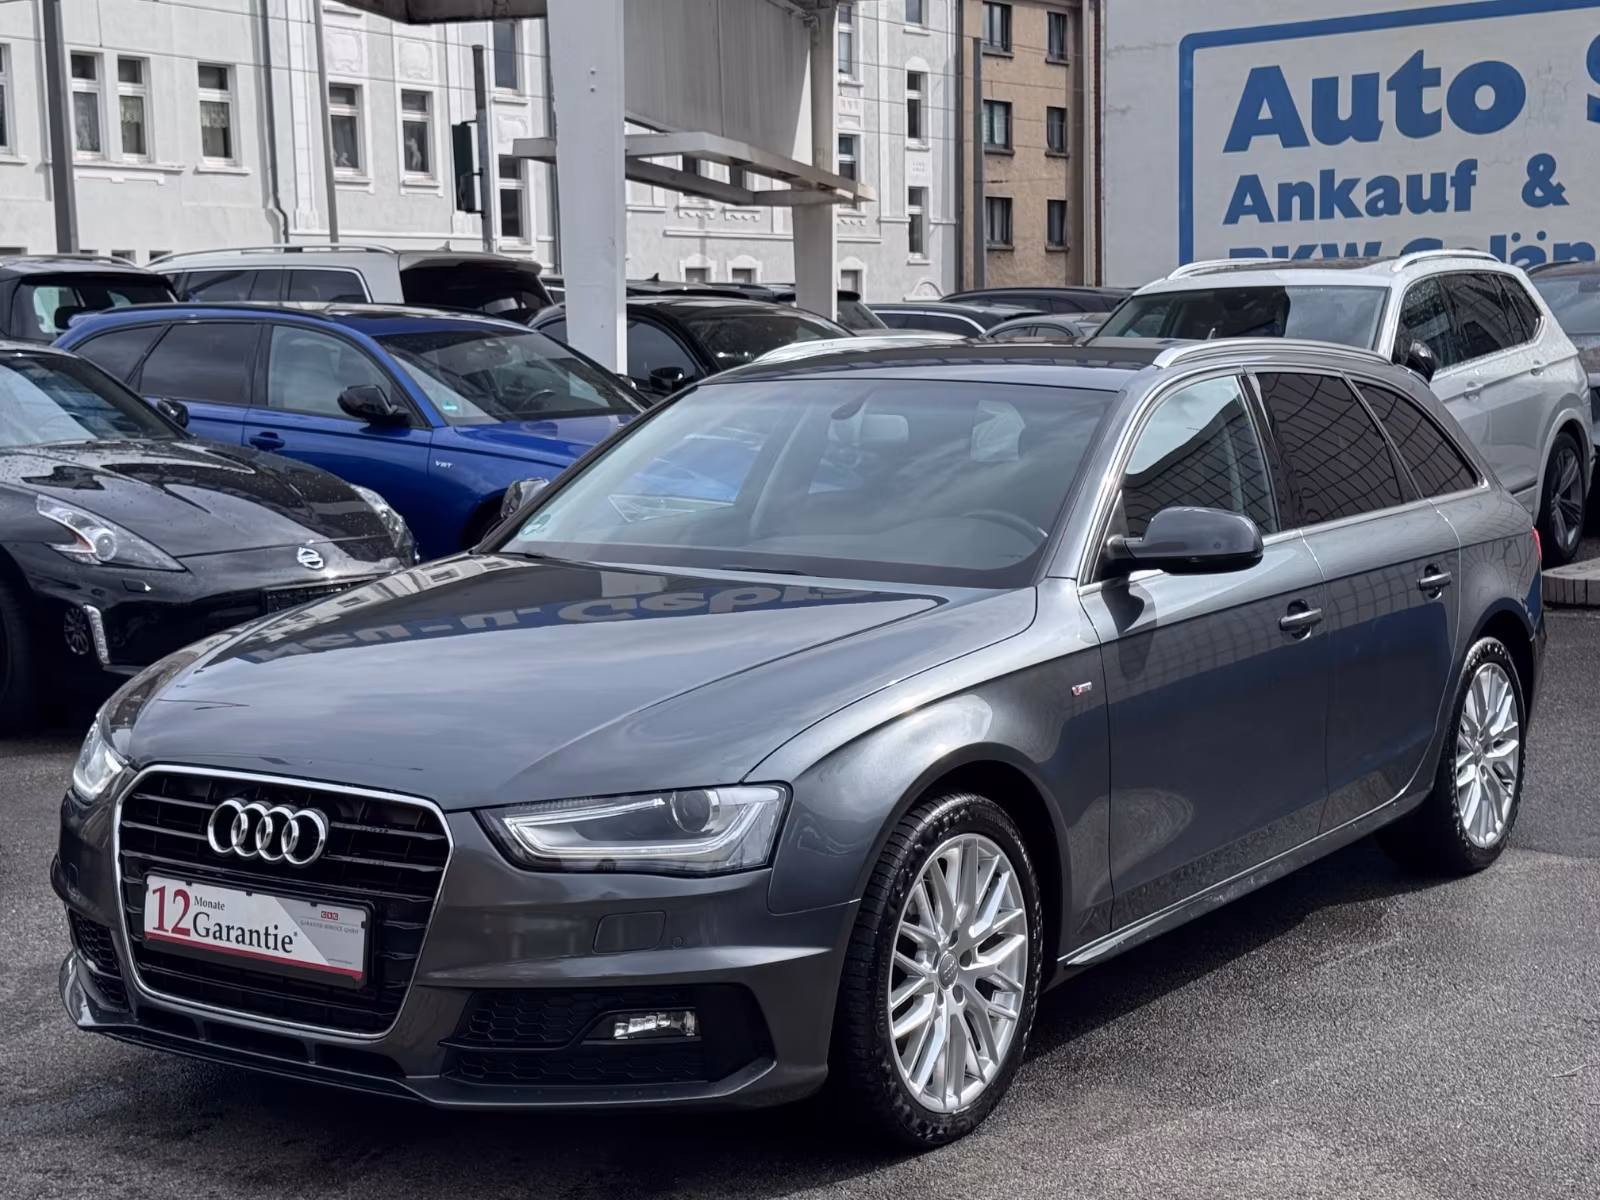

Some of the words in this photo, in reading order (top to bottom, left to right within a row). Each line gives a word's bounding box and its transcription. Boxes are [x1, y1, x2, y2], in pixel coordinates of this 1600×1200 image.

[1222, 49, 1527, 153] Auto
[1222, 158, 1478, 225] Ankauf
[1521, 153, 1570, 208] &
[152, 885, 191, 937] 12
[194, 895, 225, 911] Monate
